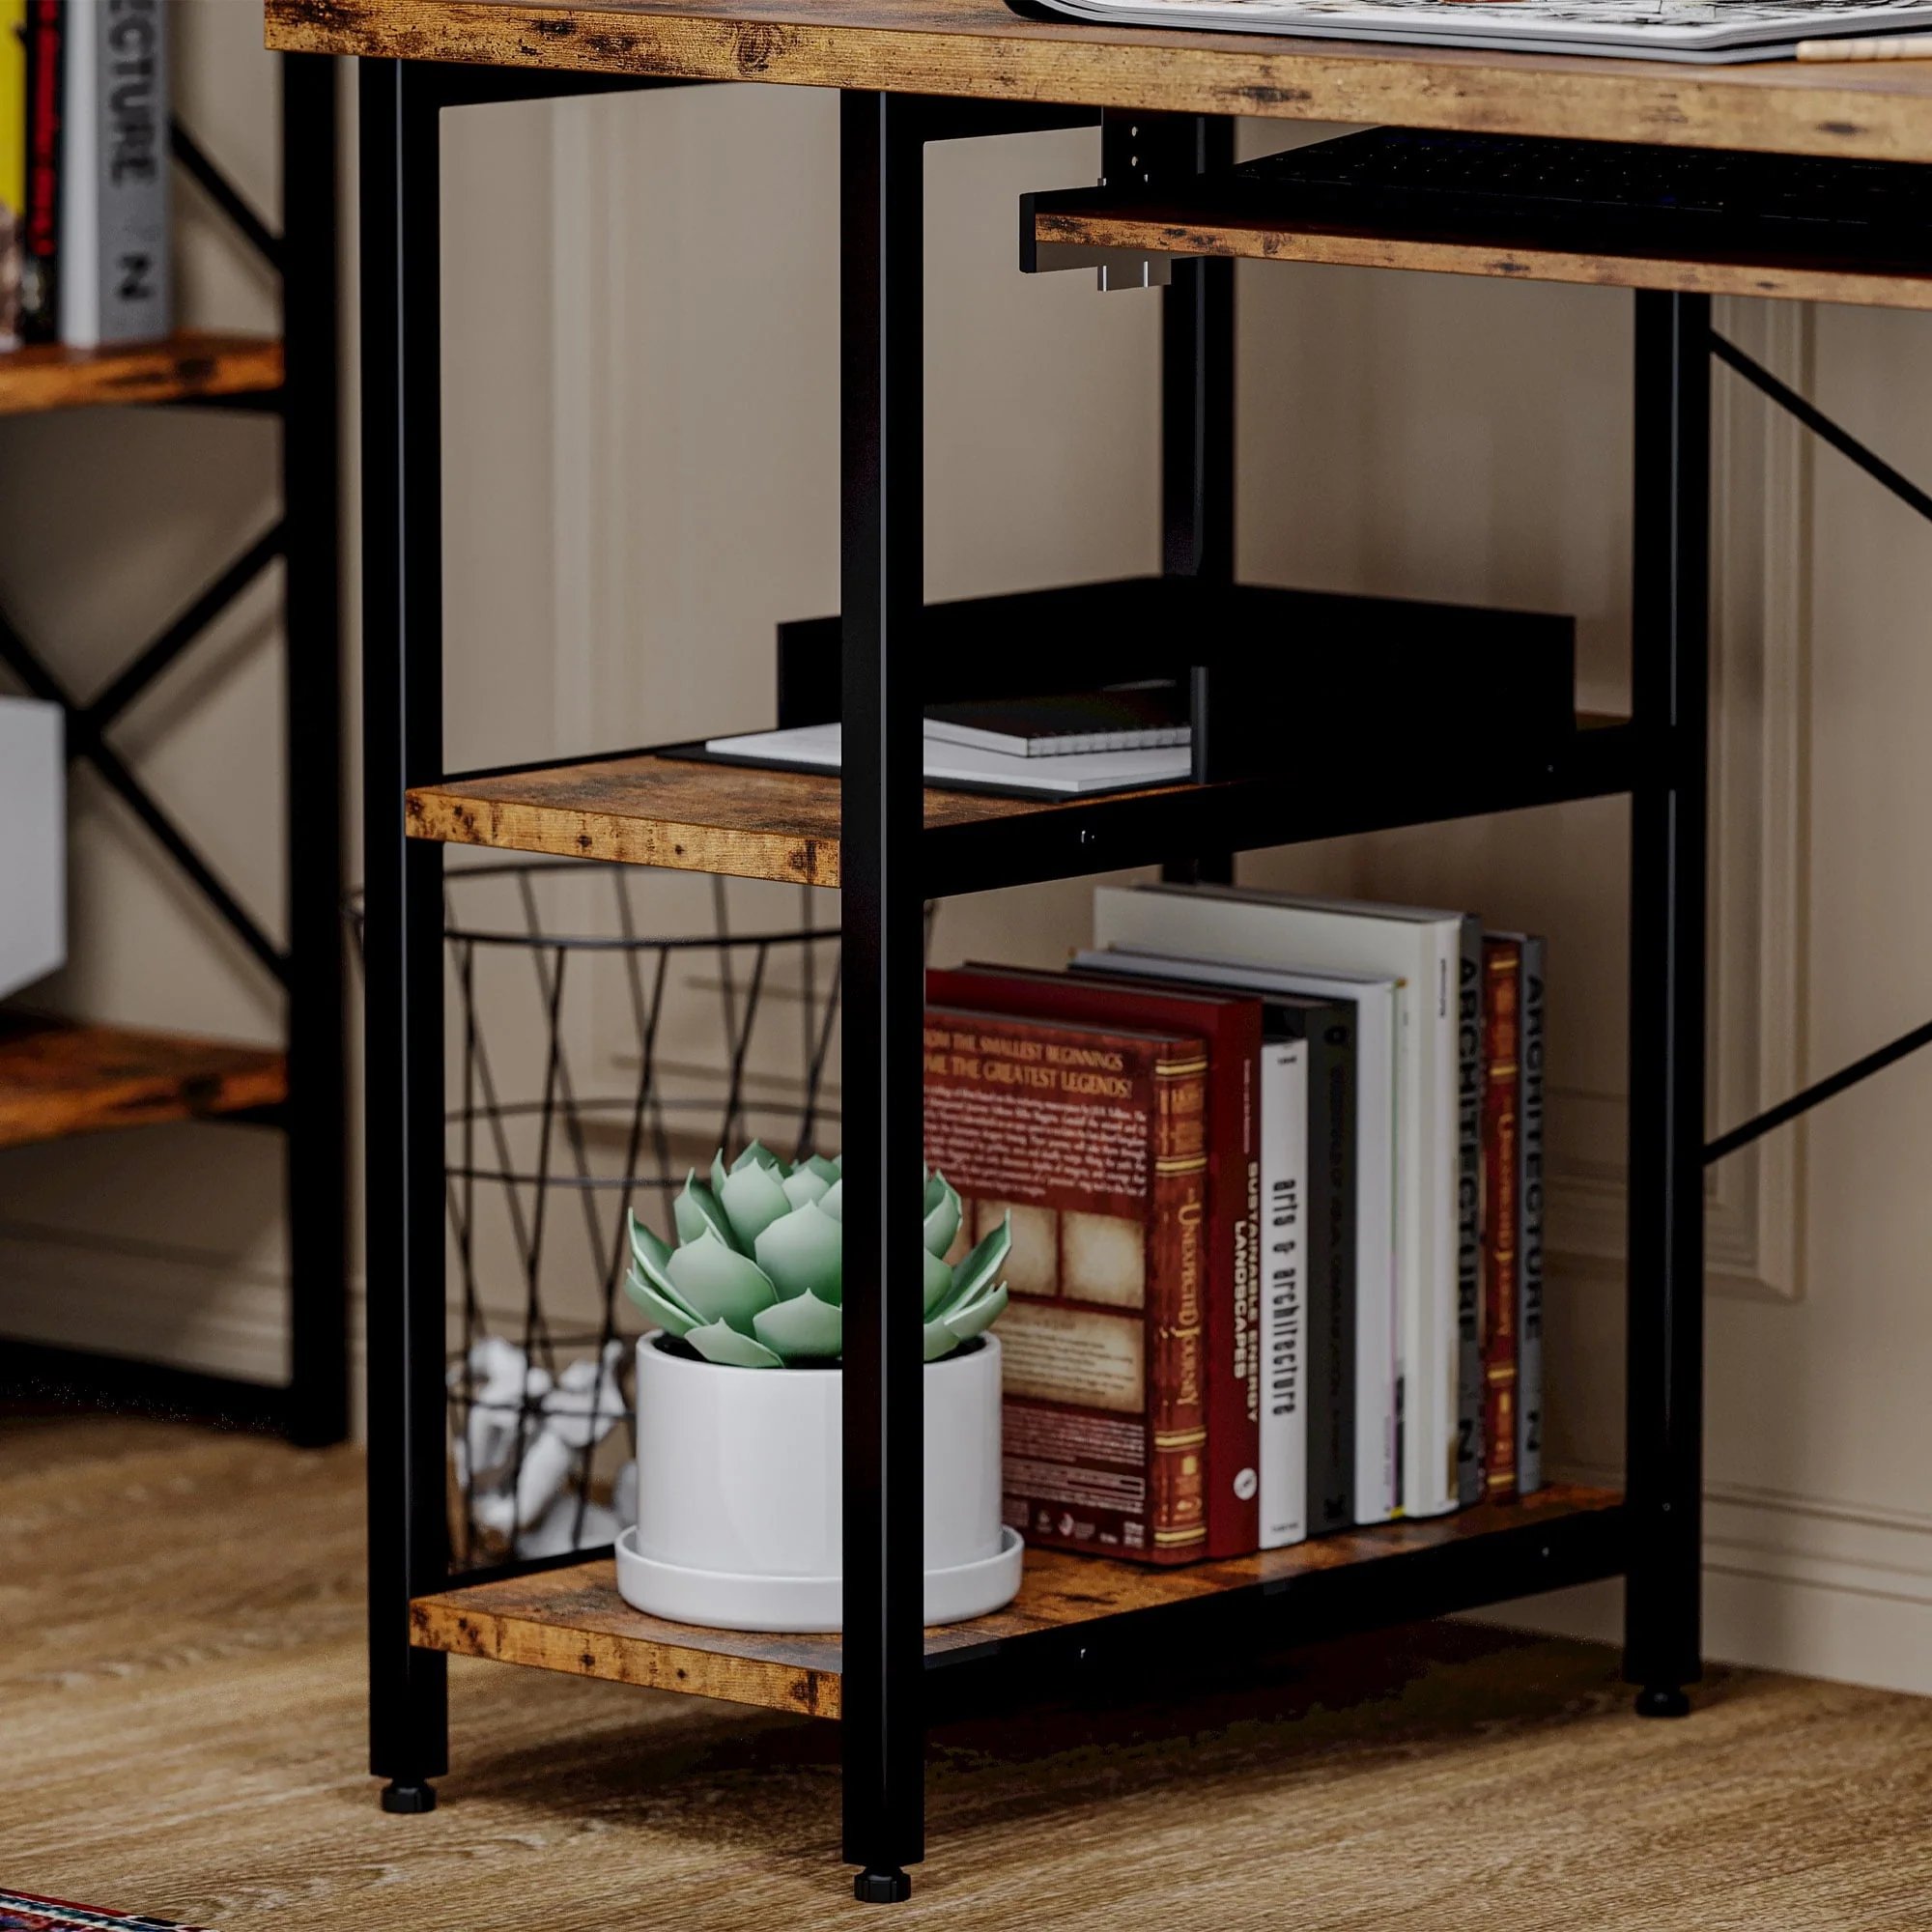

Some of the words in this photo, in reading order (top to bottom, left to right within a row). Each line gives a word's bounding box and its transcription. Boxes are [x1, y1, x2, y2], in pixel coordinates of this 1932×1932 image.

[983, 1059, 1057, 1089] GREATEST
[1045, 1043, 1123, 1071] BEGINNINGS
[1271, 1179, 1298, 1227] arts
[1525, 975, 1545, 1341] ARCHITECTURE
[1233, 1220, 1248, 1379] LANDSCAPES
[1246, 1161, 1261, 1322] SUSTAINABLE
[1246, 1329, 1260, 1424] ENERGY
[1271, 1267, 1300, 1416] architecture
